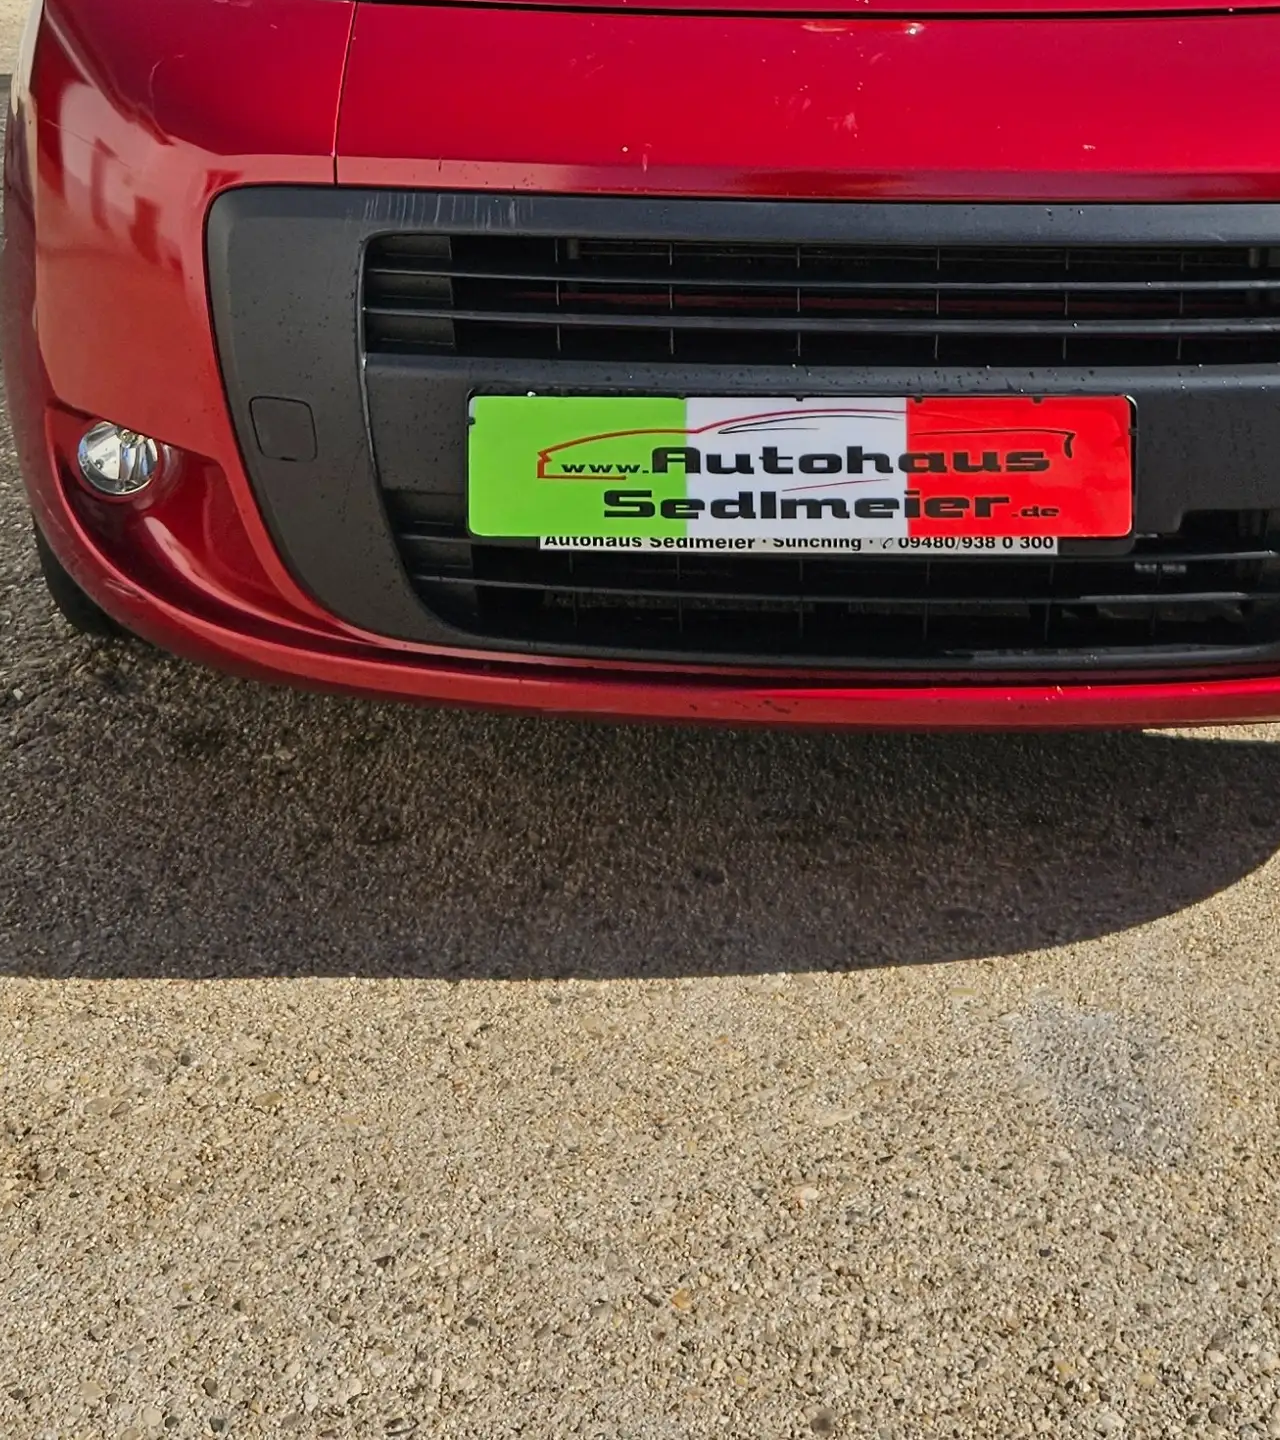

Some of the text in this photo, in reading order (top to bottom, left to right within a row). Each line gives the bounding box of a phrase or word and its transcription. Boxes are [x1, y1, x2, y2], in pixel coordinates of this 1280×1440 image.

[898, 536, 996, 550] 09480/938
[1002, 536, 1014, 549] 0
[1020, 536, 1054, 549] 300
